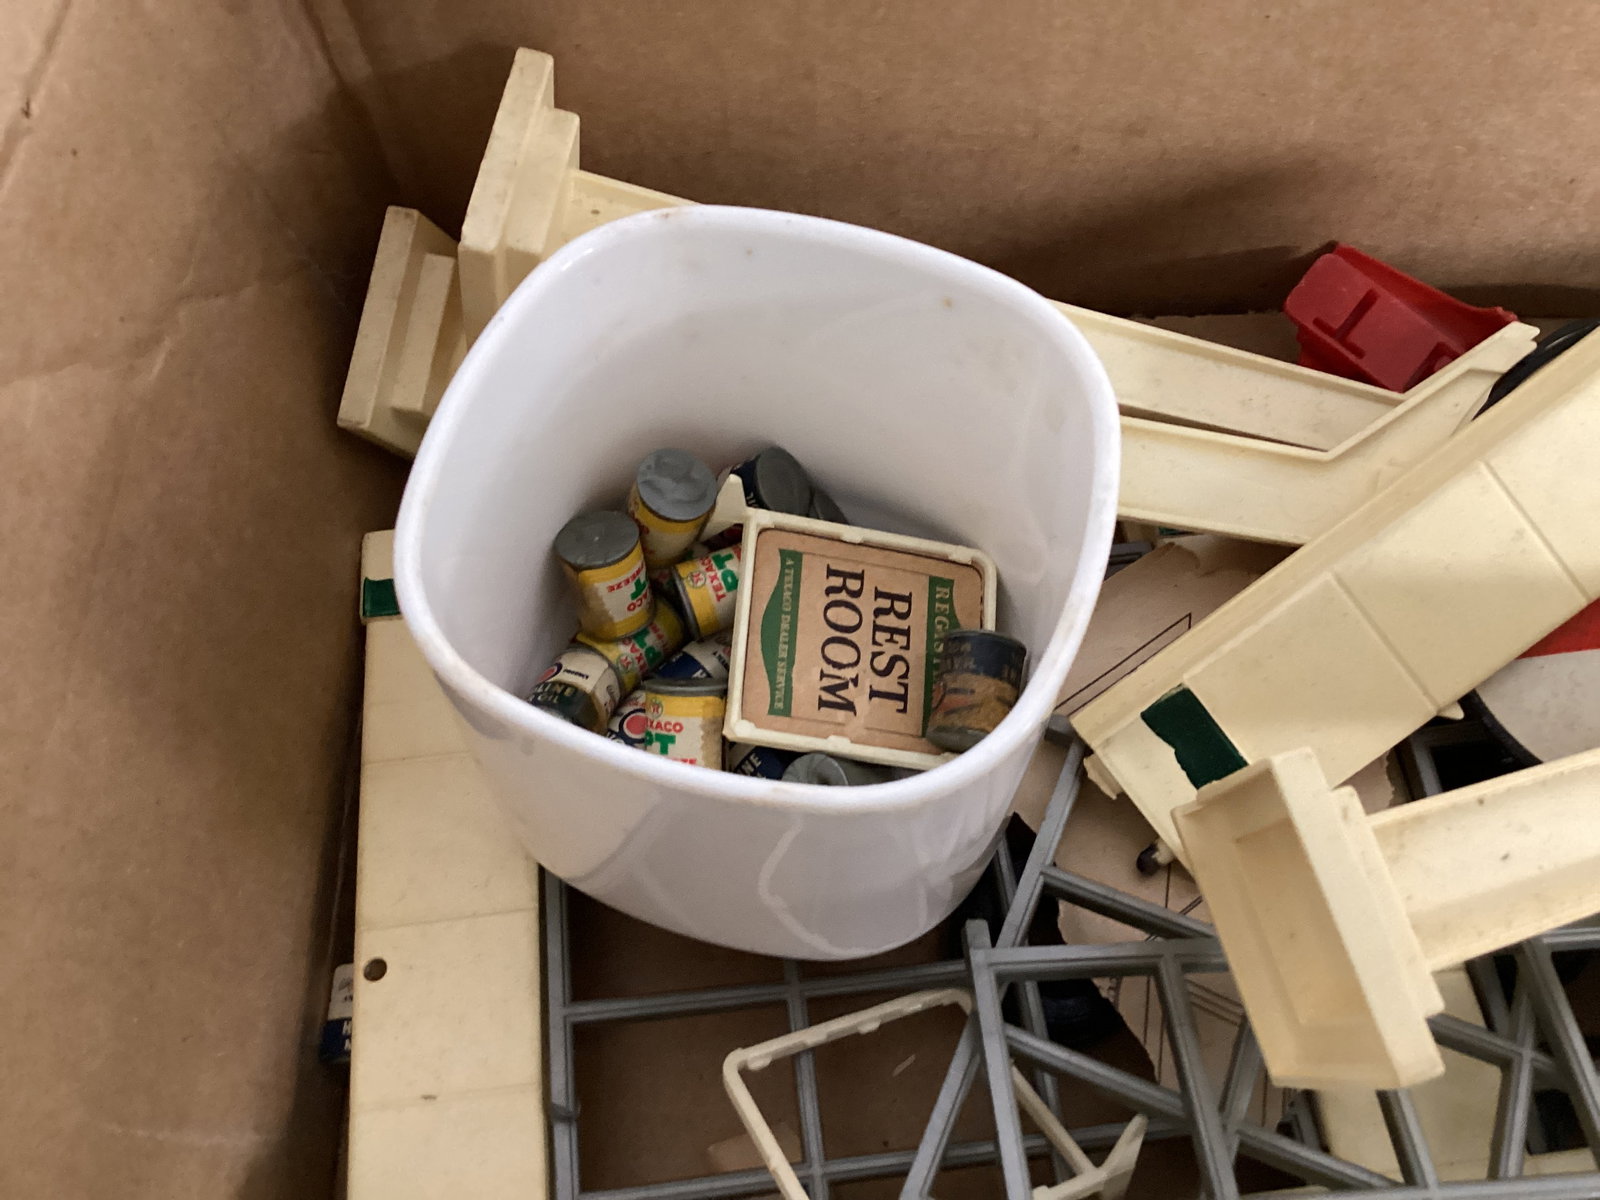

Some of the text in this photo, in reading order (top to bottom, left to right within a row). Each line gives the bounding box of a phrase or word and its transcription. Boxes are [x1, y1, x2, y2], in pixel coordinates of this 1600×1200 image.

[781, 568, 794, 611] TEXACO
[777, 614, 790, 657] DEALER
[817, 563, 865, 717] ROOM
[868, 586, 913, 714] REST
[773, 661, 787, 709] SERVICE
